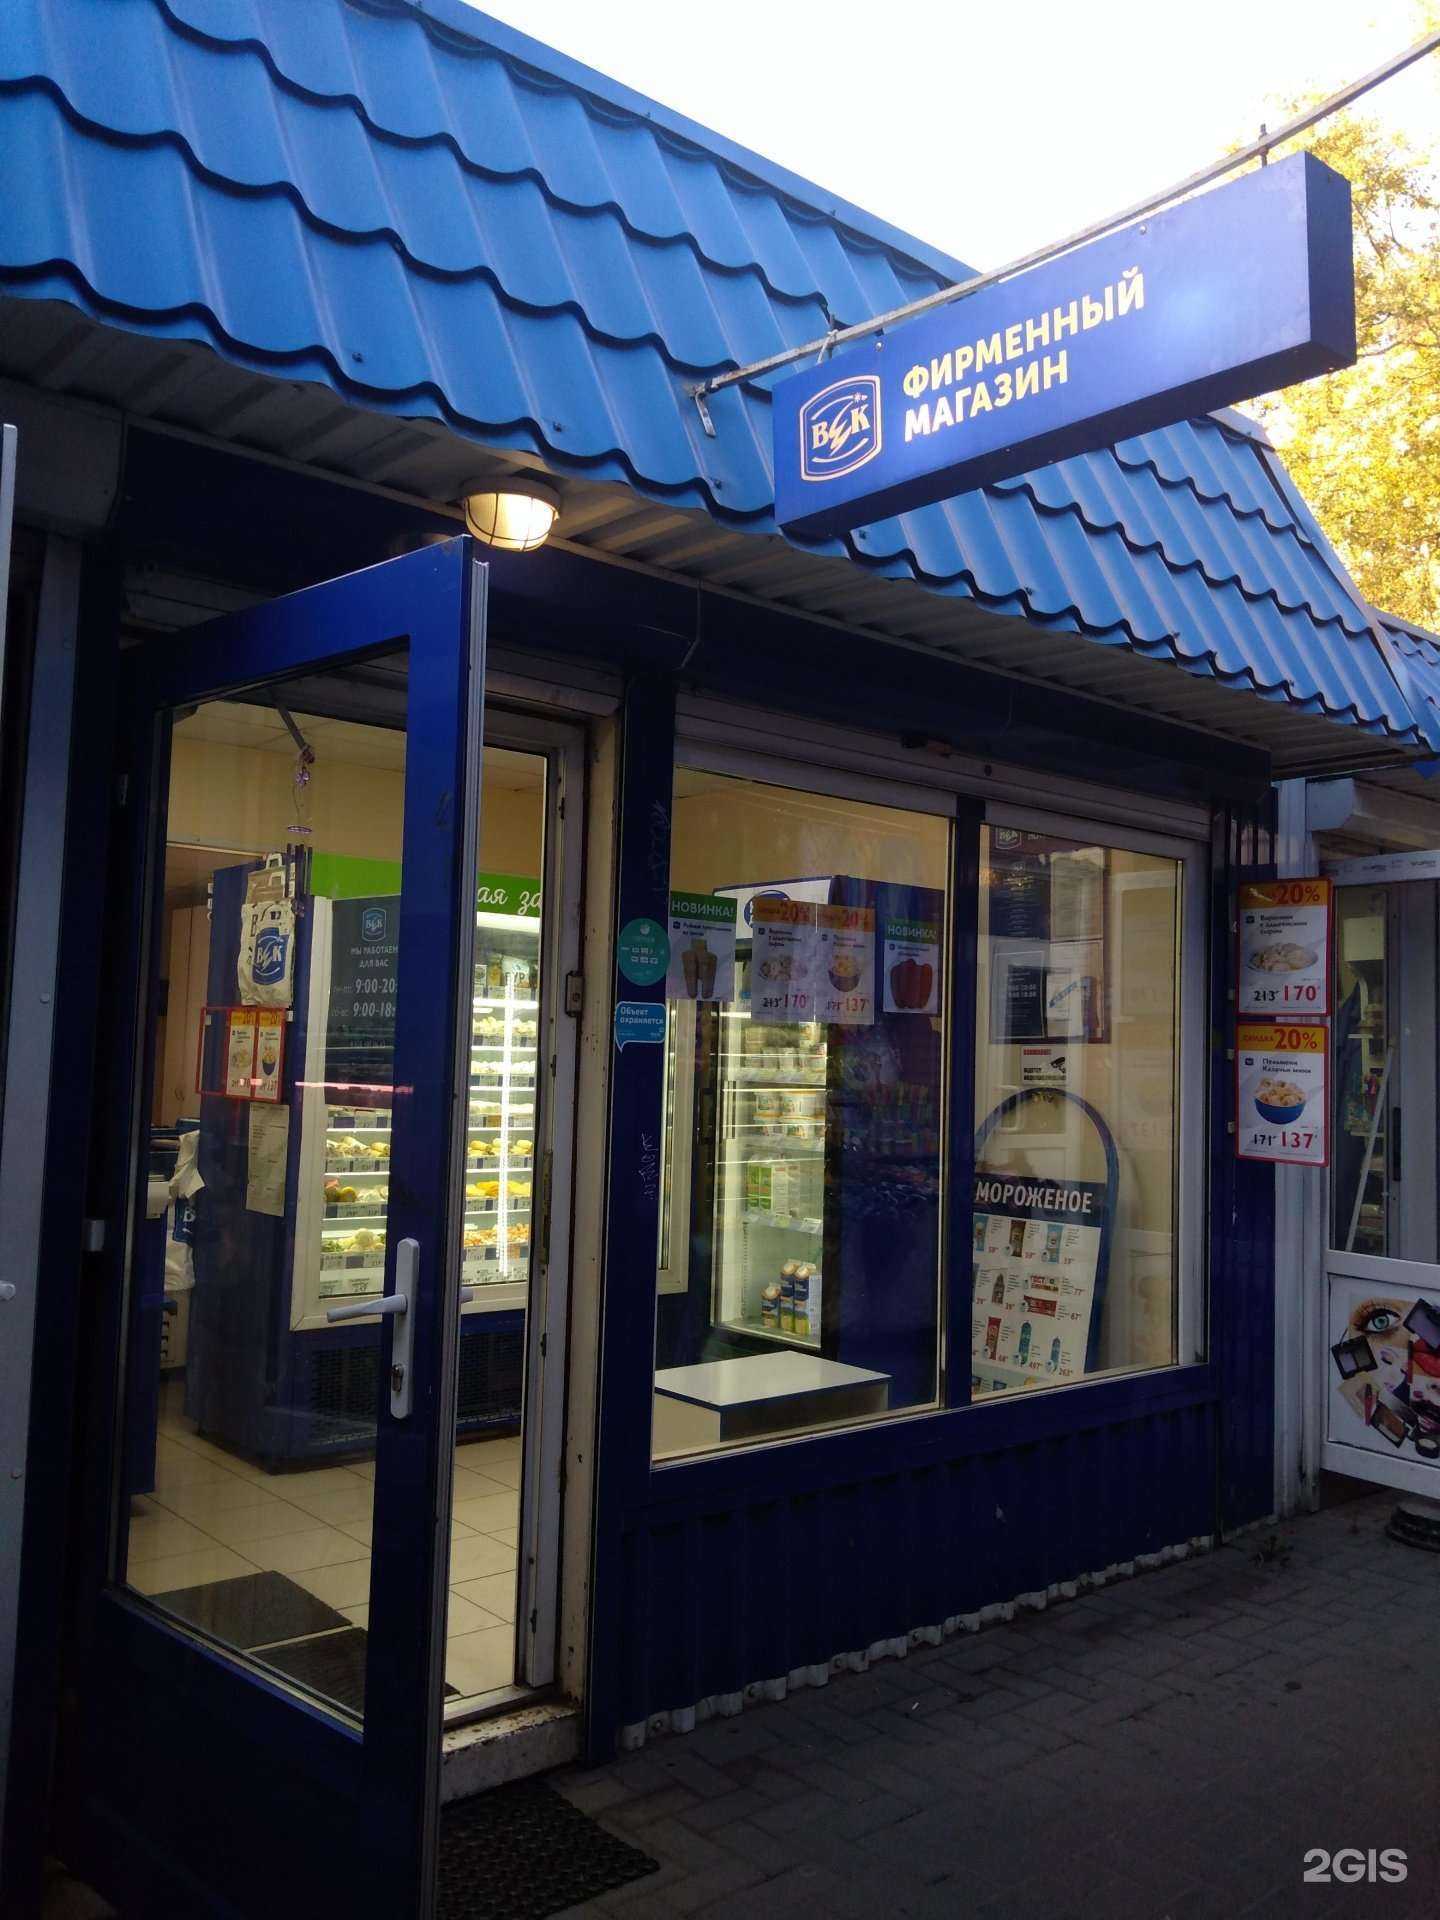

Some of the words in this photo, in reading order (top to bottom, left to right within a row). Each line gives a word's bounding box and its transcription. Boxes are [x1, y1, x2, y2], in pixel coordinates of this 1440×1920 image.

[903, 266, 1145, 400] ФИРМЕННЫЙ
[904, 350, 1069, 443] МАГАЗИН
[477, 886, 509, 905] ая
[517, 890, 542, 915] за
[671, 900, 734, 917] НОВИНКА!
[355, 978, 398, 994] 9:00-20:
[1284, 985, 1317, 1001] 170
[353, 1001, 396, 1018] 9:00-18:
[620, 1006, 649, 1016] Объект
[619, 1016, 665, 1026] охраняется
[1274, 1028, 1318, 1050] 20%
[1282, 1131, 1314, 1149] 137
[975, 1180, 1094, 1214] МОРОЖЕНОЕ
